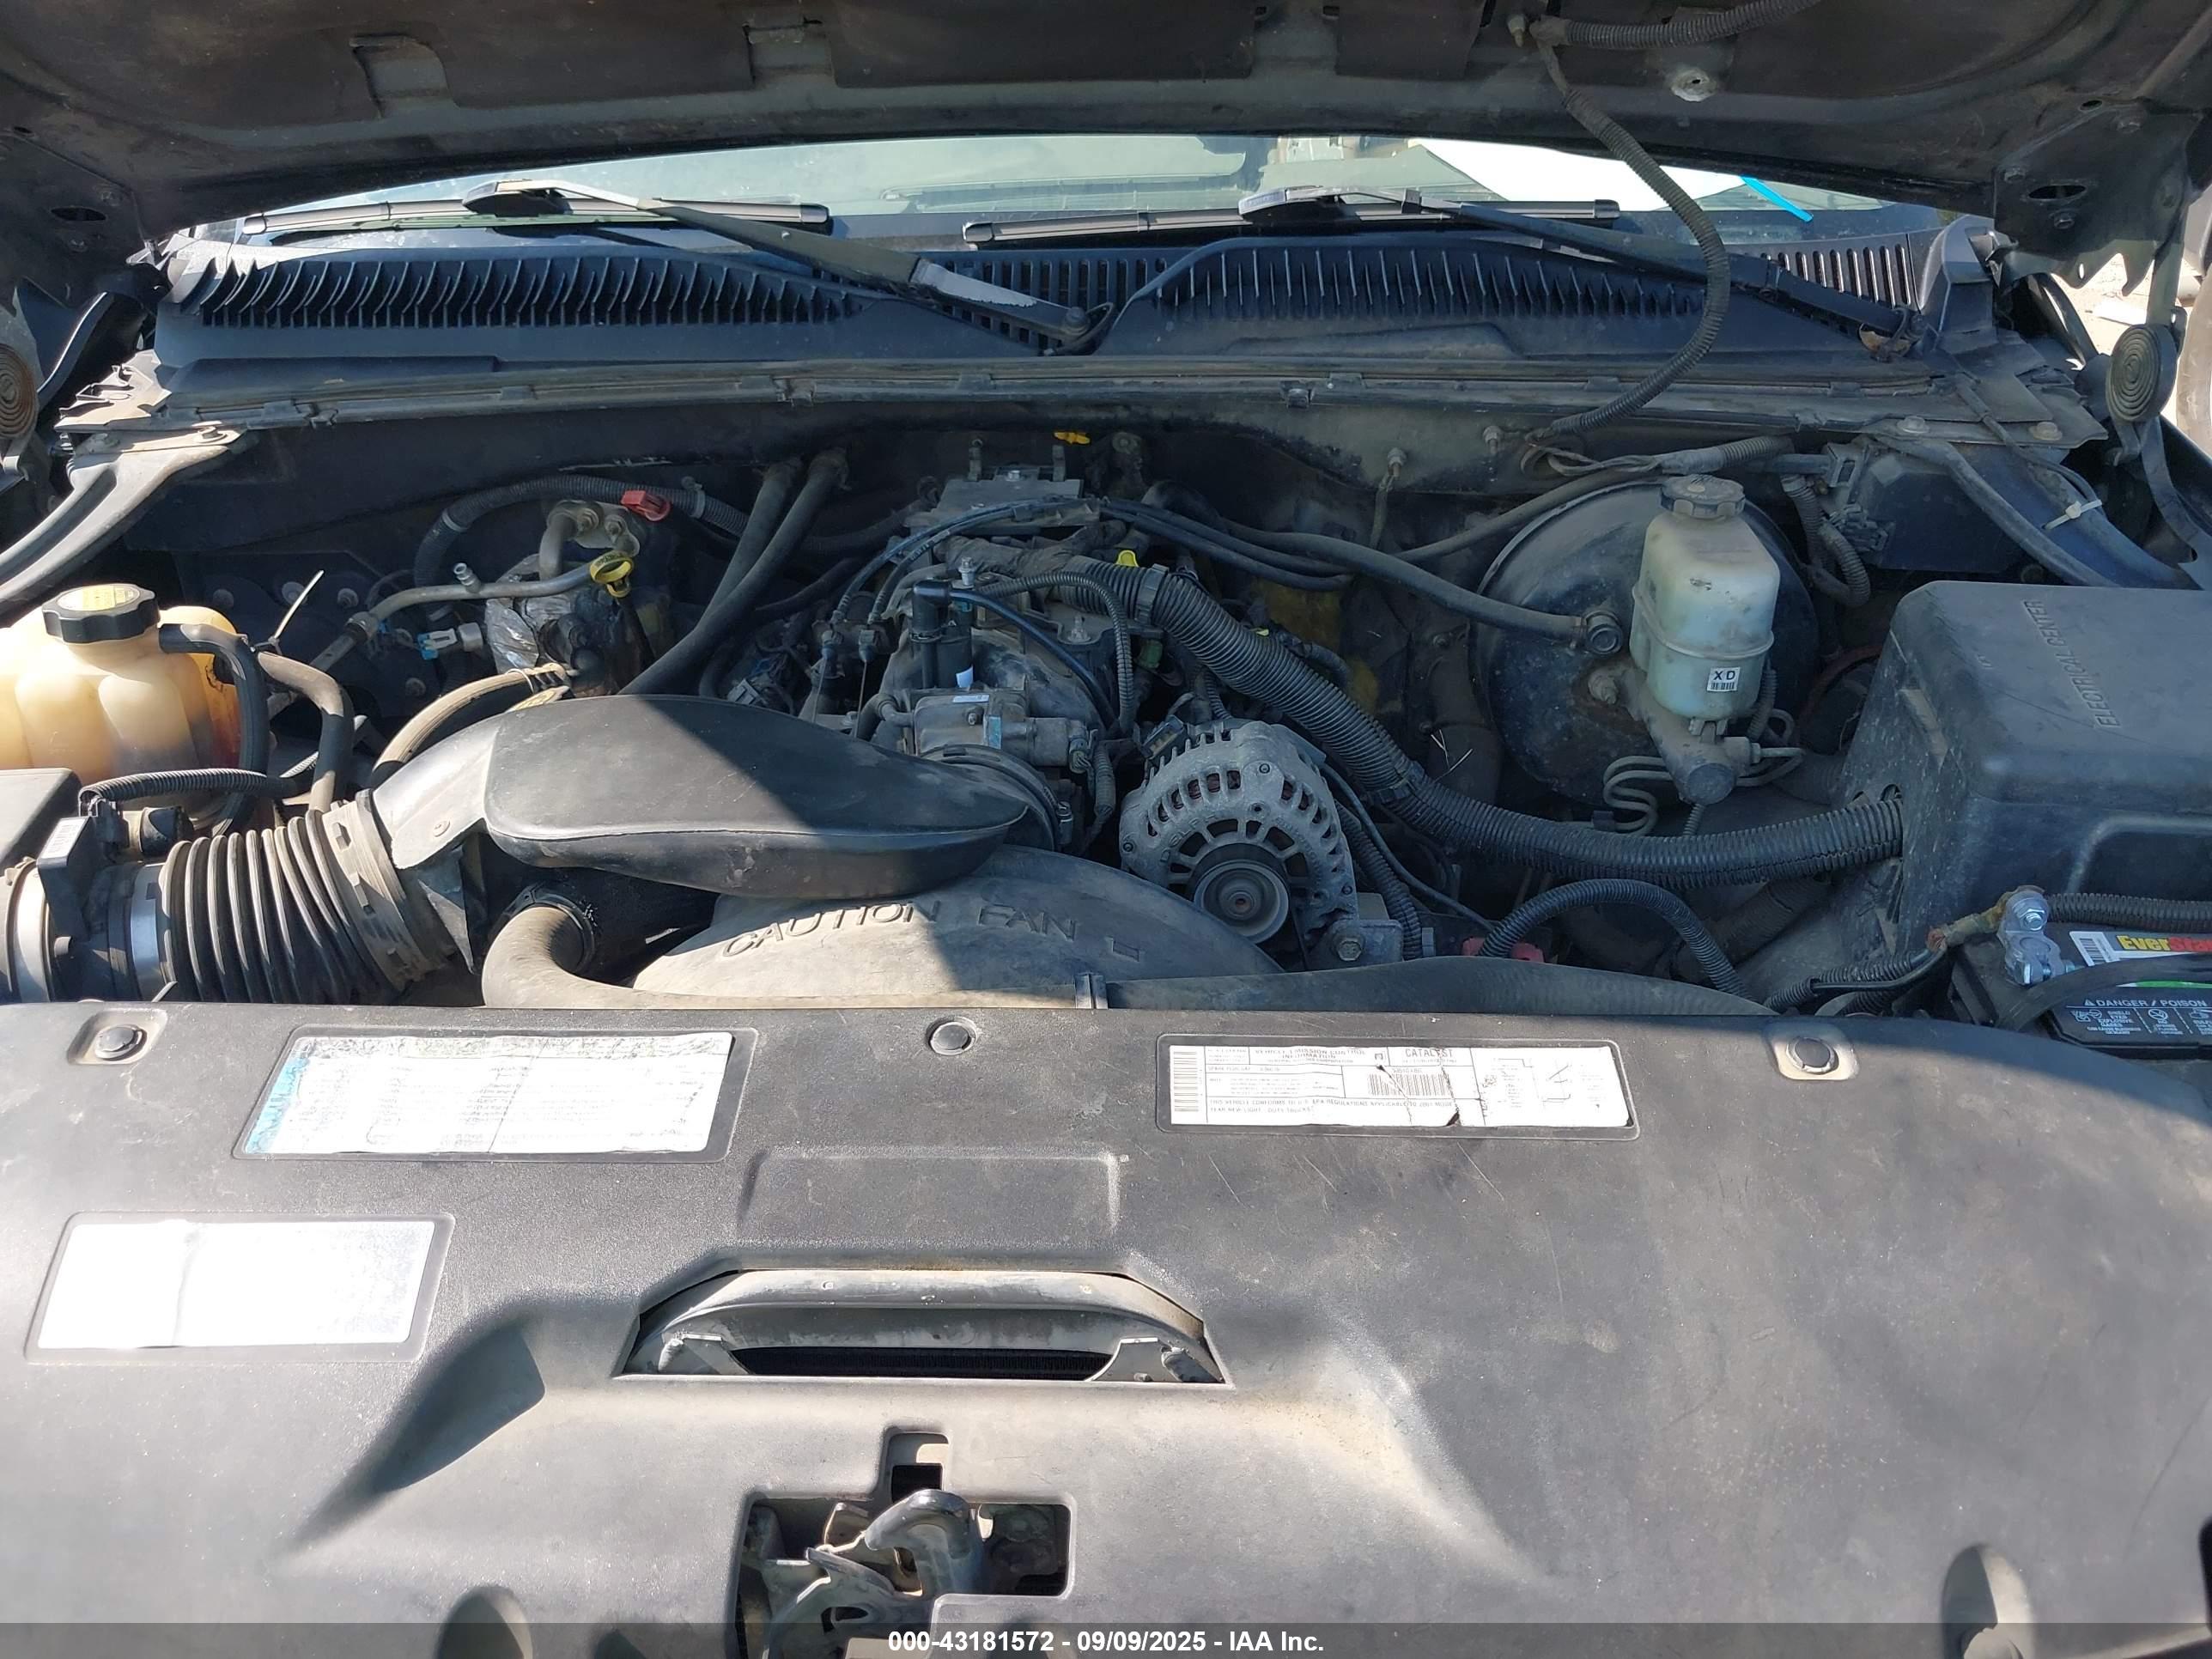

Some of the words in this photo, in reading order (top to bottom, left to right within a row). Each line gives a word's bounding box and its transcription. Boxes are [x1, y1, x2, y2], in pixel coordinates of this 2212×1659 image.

[2022, 599, 2068, 647] CENTER
[2054, 650, 2121, 726] ELECTRICAL
[721, 899, 941, 958] CAUTION
[978, 902, 1078, 942] FAN
[1405, 1048, 1454, 1057] CATALYST
